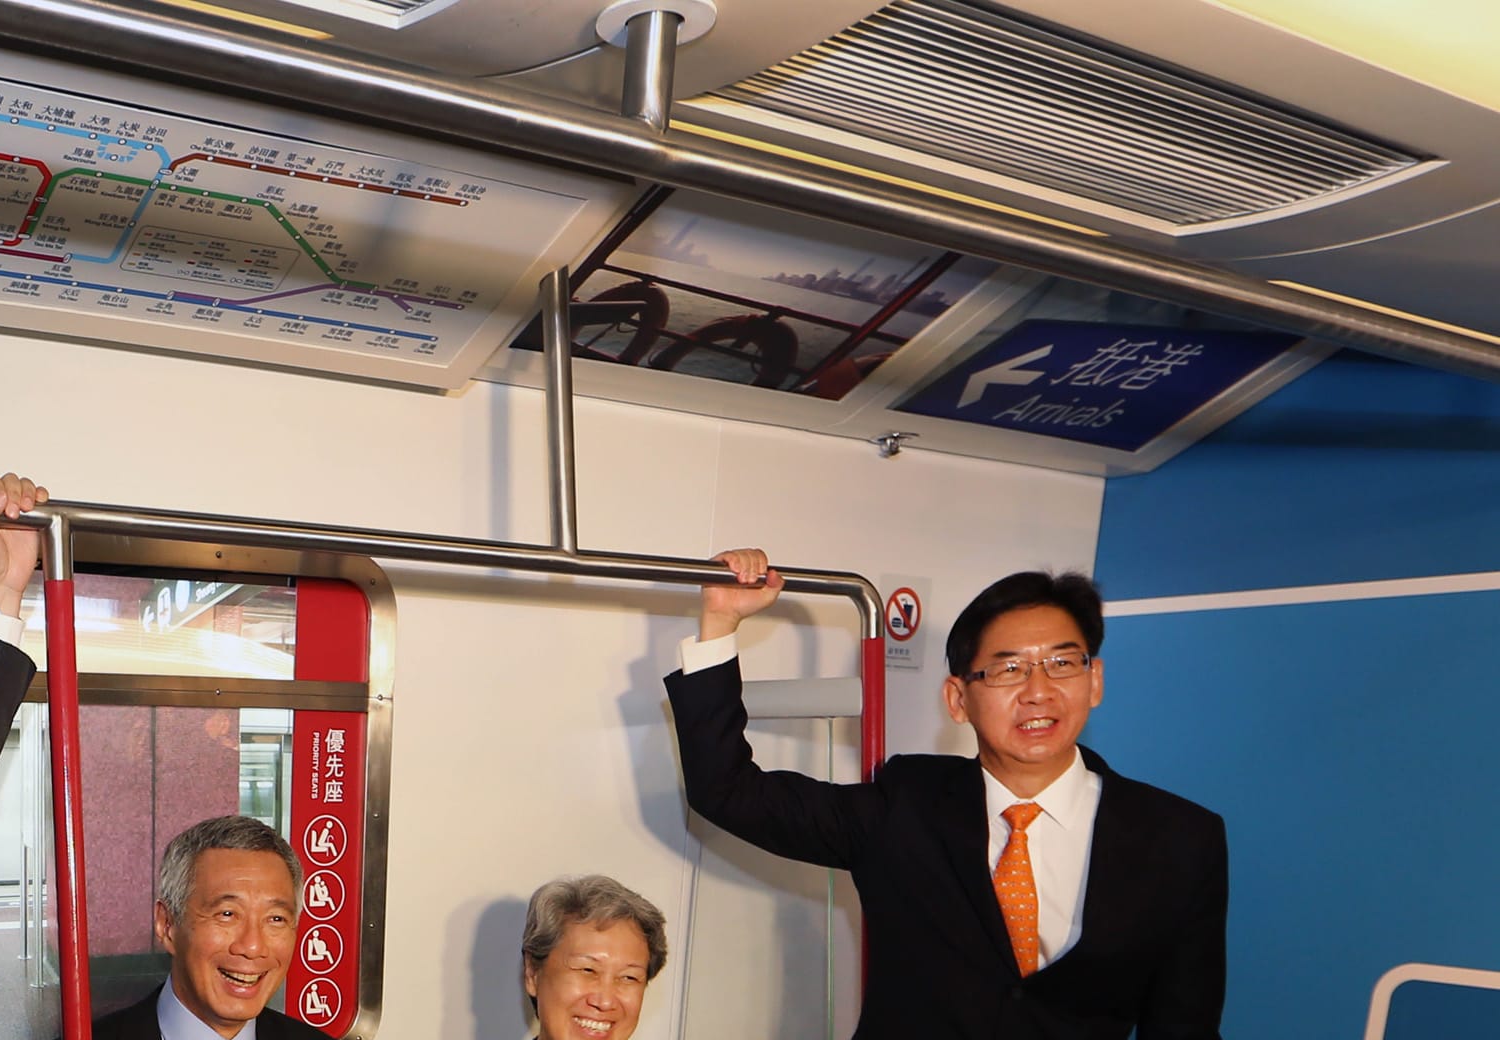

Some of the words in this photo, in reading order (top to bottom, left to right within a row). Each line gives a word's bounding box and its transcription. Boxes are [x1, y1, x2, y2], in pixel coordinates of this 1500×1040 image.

[1051, 338, 1203, 391] 抵港
[994, 393, 1125, 428] Arrivals
[312, 732, 320, 771] PRIORITY
[324, 728, 346, 803] 優先座
[311, 772, 319, 799] SEATS
